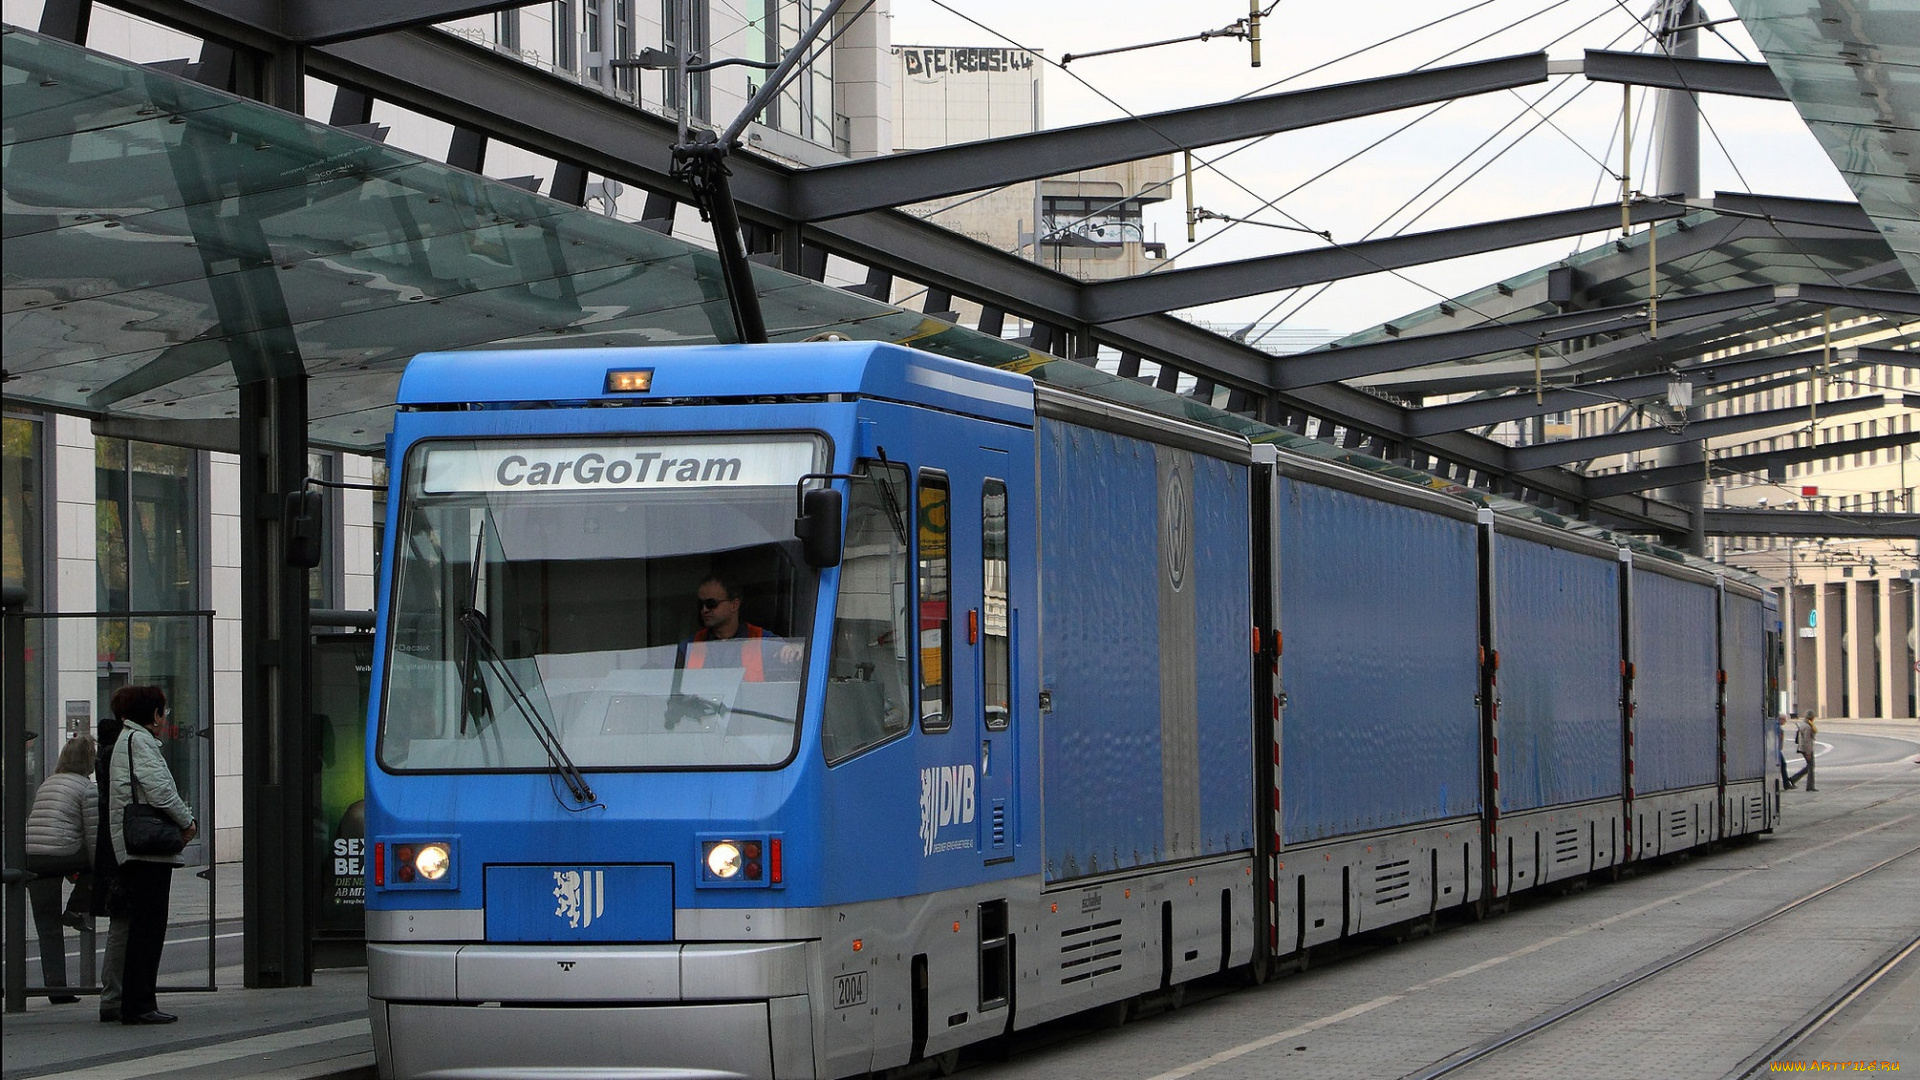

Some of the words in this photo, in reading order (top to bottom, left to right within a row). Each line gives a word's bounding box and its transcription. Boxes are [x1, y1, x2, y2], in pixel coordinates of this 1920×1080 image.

[496, 452, 742, 487] CarGoTram
[355, 664, 373, 672] Weib
[940, 764, 975, 827] DVB
[334, 858, 365, 875] BE
[839, 975, 863, 1005] 2004
